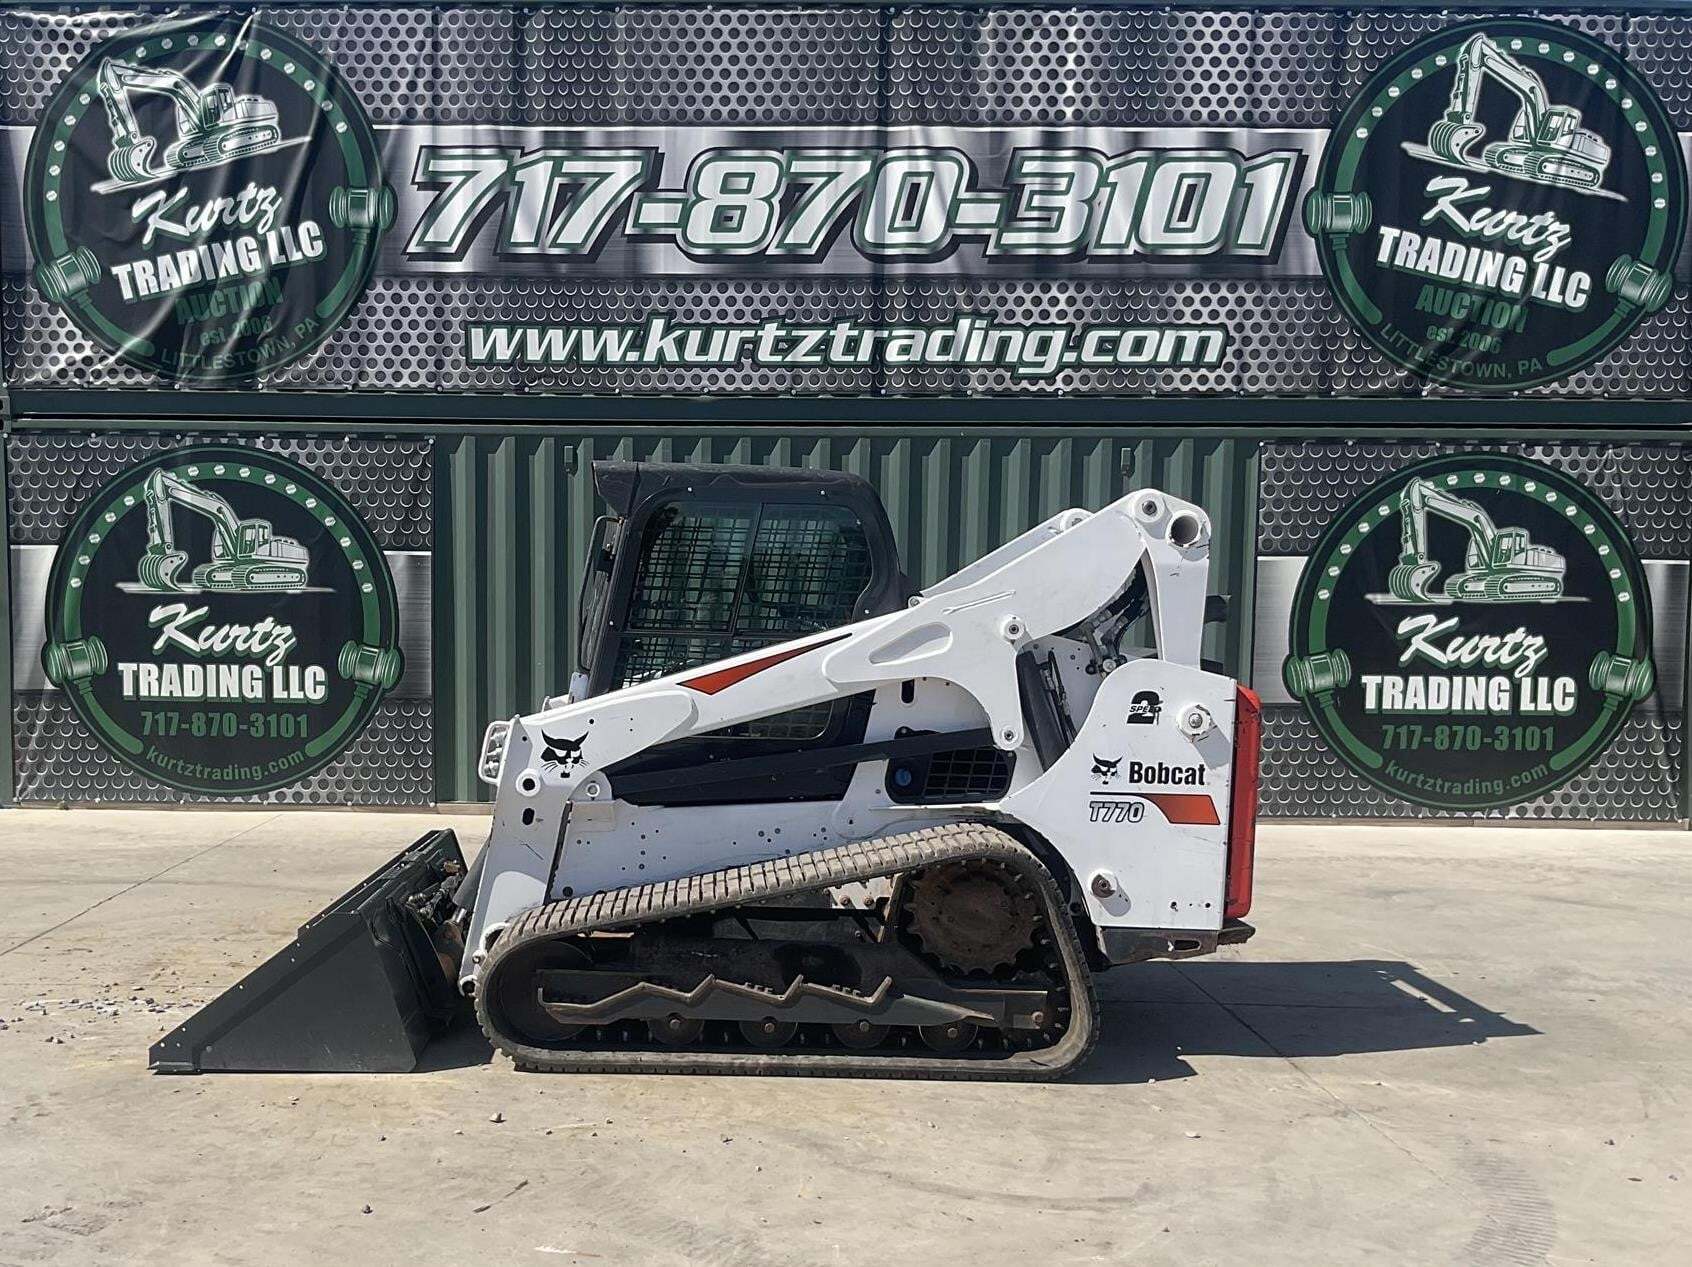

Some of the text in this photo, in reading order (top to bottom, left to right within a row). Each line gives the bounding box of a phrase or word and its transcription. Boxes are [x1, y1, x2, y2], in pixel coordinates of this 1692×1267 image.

[133, 183, 282, 248] Kurtz
[405, 146, 1304, 261] 717-870-3101
[1420, 176, 1571, 263] Kurtz
[111, 220, 325, 300] TRADING LLC
[1375, 226, 1592, 311] TRADING LLC
[175, 276, 283, 324] AUCTION
[1415, 283, 1529, 333] AUCTION
[294, 317, 319, 339] PA
[467, 315, 1227, 377] www.kurtztrading.com
[1518, 358, 1542, 375] PA
[148, 603, 297, 667] Kurtz
[1397, 614, 1548, 678] Kurtz
[117, 662, 328, 702] TRADING LLC
[1361, 675, 1577, 714] TRADING LLC
[140, 711, 309, 738] 717-870-3101
[1127, 691, 1160, 724] 2
[1382, 725, 1555, 751] 717-870-3101
[145, 745, 305, 780] kurtztrading.com
[1129, 761, 1206, 785] Bobcat
[1385, 760, 1548, 795] kurtztrading.com
[1089, 801, 1145, 823] T770
